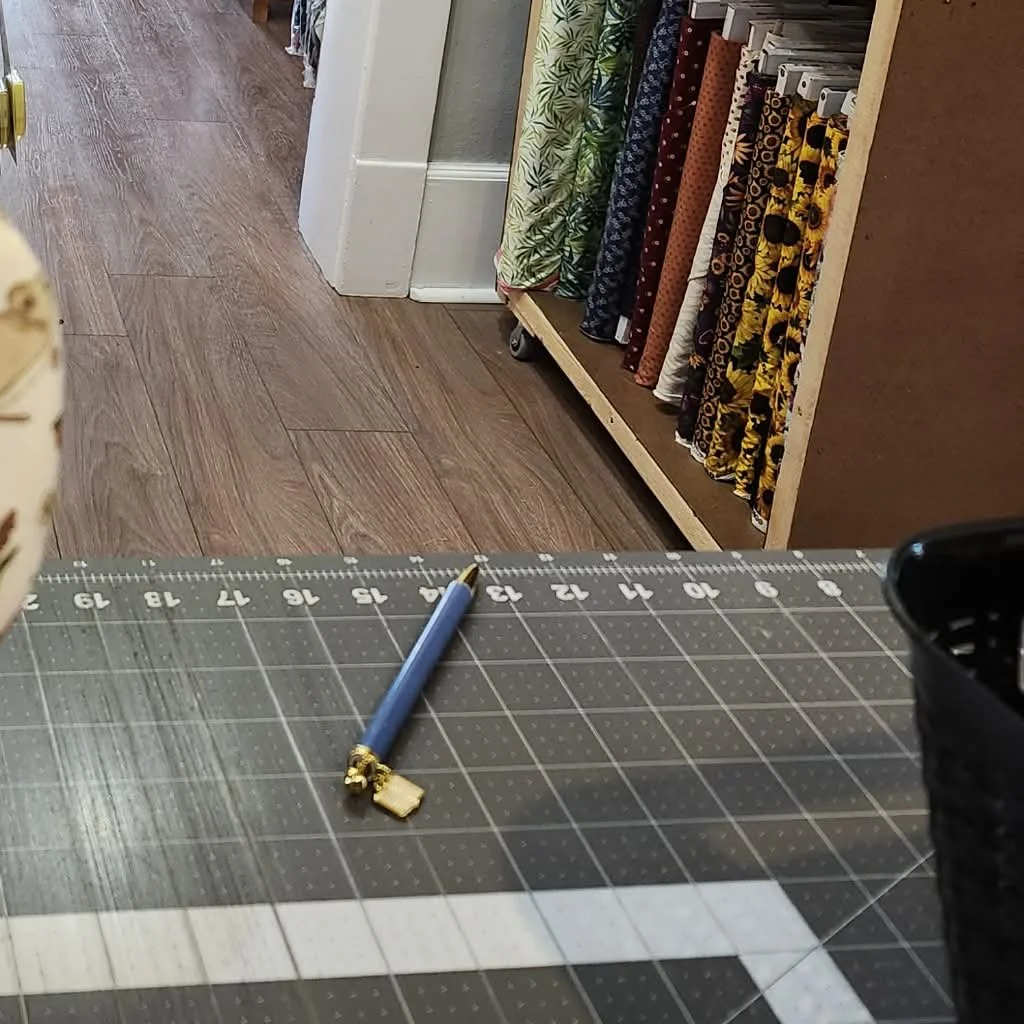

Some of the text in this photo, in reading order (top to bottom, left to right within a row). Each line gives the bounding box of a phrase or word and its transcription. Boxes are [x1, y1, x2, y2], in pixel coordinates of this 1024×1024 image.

[74, 592, 110, 609] 19
[143, 591, 181, 608] 18
[217, 590, 251, 607] 17
[282, 589, 320, 606] 16
[351, 587, 388, 604] 15
[485, 585, 523, 602] 13
[550, 584, 589, 601] 12
[618, 583, 654, 600] 11
[682, 582, 721, 599] 10
[754, 580, 779, 598] 9
[817, 579, 842, 597] 8
